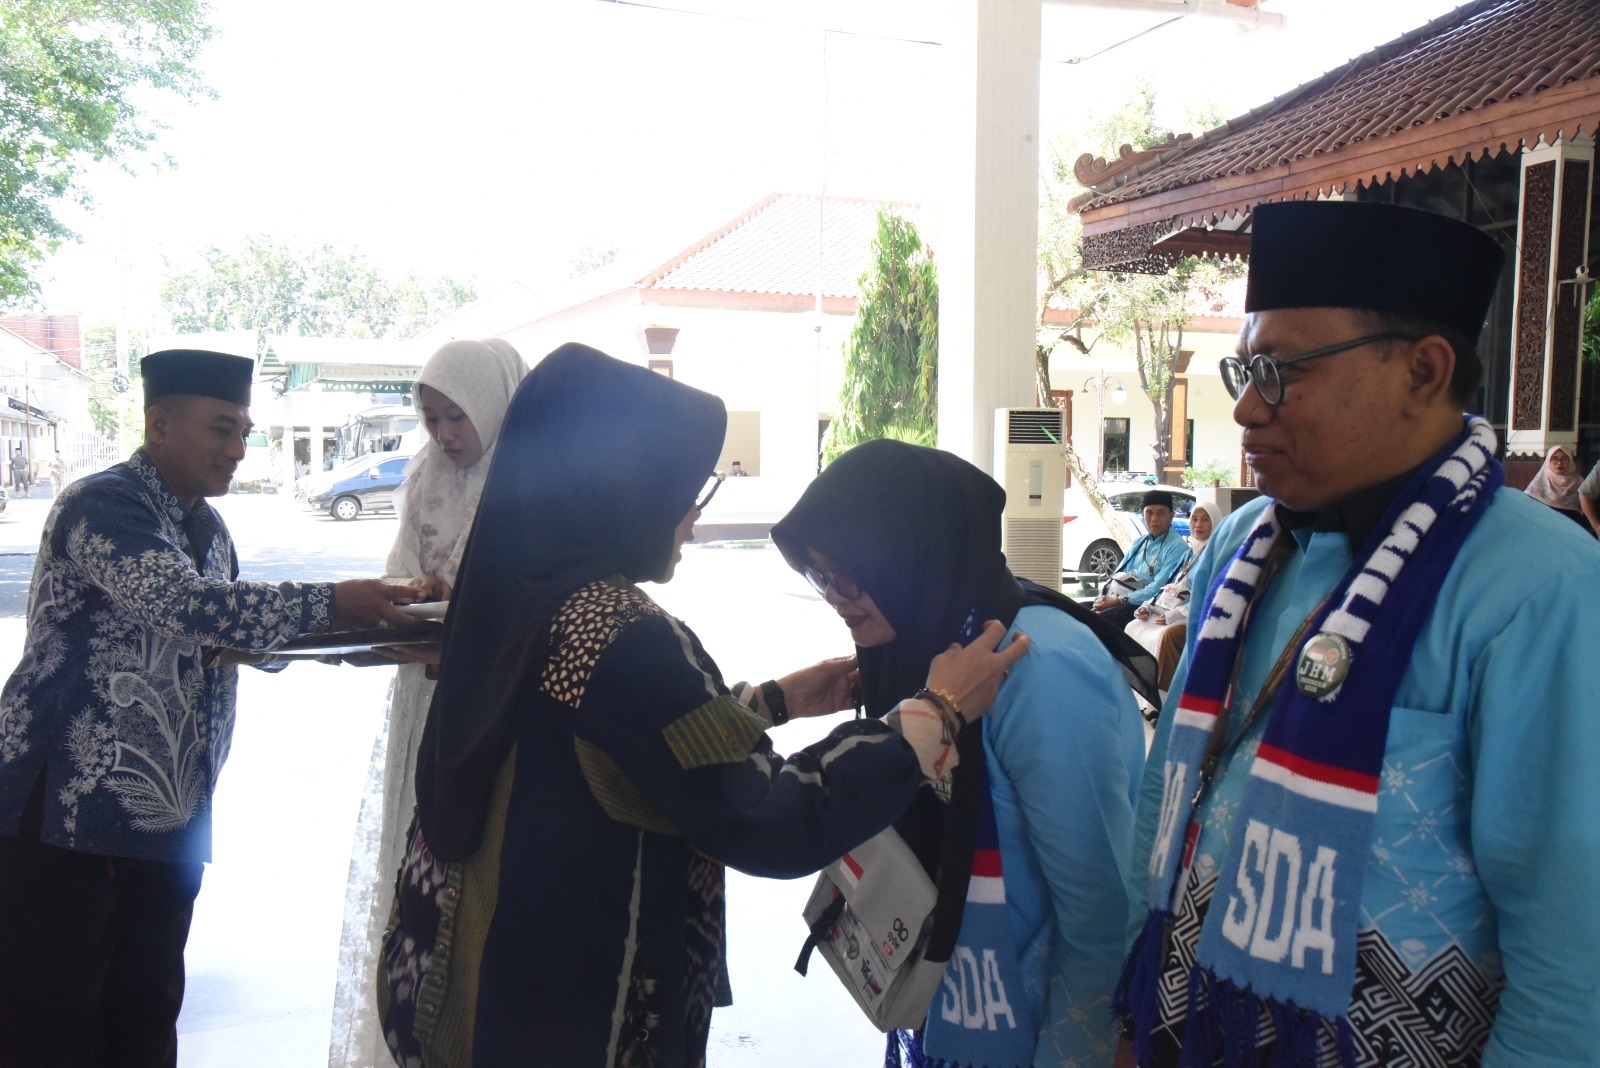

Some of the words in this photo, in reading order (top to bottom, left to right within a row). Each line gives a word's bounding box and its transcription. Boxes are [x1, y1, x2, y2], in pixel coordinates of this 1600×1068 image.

[1299, 661, 1337, 683] JHM
[1222, 818, 1338, 975] SDA
[941, 946, 1017, 1032] SDA
